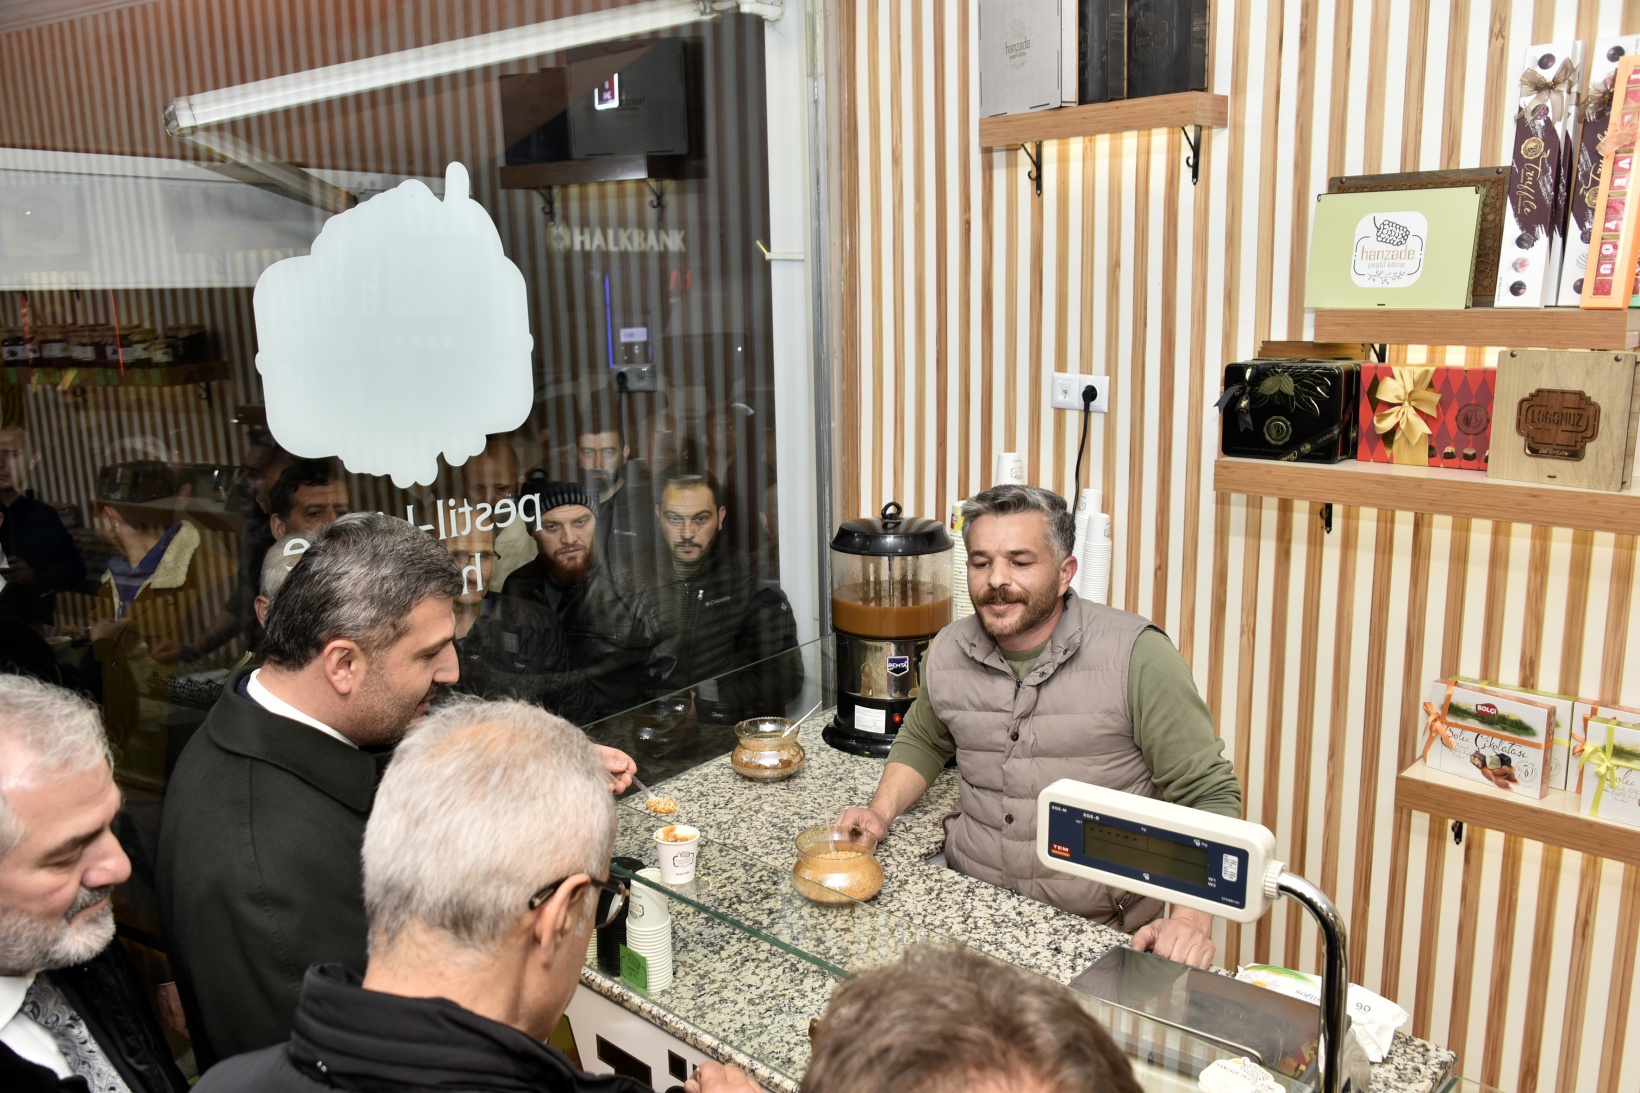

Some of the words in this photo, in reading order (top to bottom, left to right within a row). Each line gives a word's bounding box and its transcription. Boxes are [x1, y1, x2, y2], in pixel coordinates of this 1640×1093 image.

[1004, 36, 1031, 55] hanzade
[1516, 149, 1550, 216] Truffle
[573, 227, 686, 252] HALKBANK
[1361, 244, 1415, 261] hanzade
[1052, 844, 1069, 852] TEM
[1355, 1002, 1371, 1013] 90
